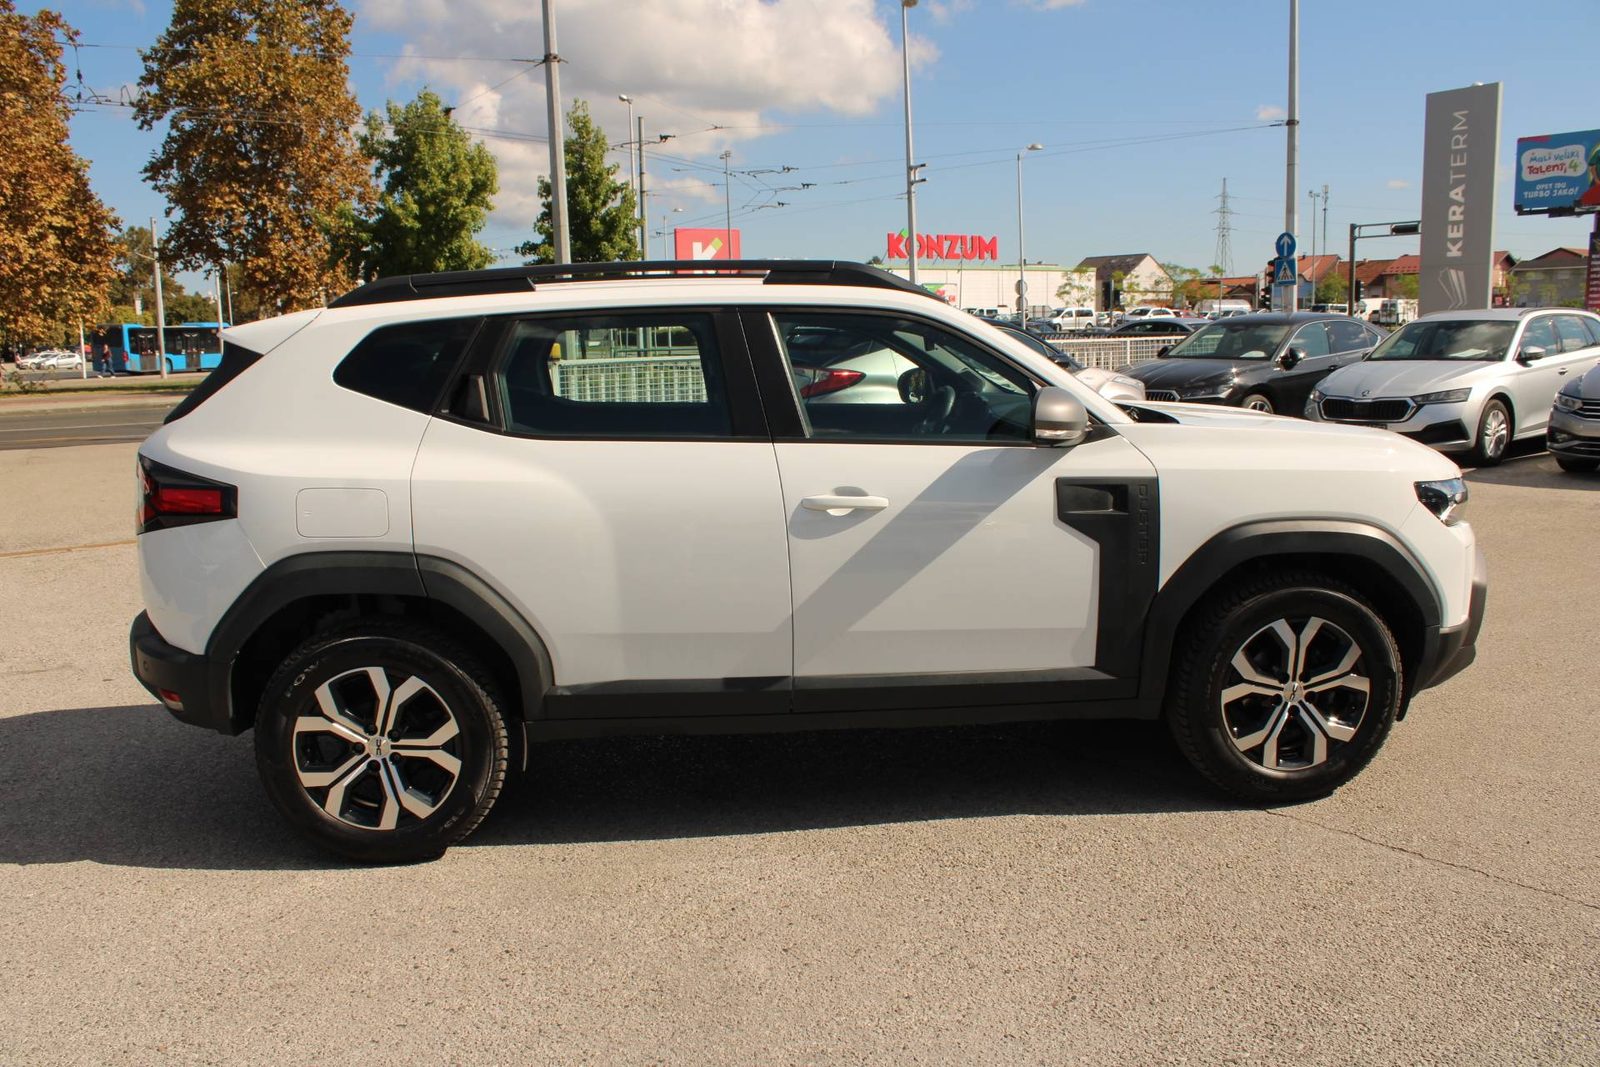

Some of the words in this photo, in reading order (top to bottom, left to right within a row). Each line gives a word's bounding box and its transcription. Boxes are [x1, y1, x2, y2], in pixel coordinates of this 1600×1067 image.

[1568, 159, 1579, 172] 4
[1446, 109, 1470, 258] KERATERM
[887, 229, 998, 261] KONZUM
